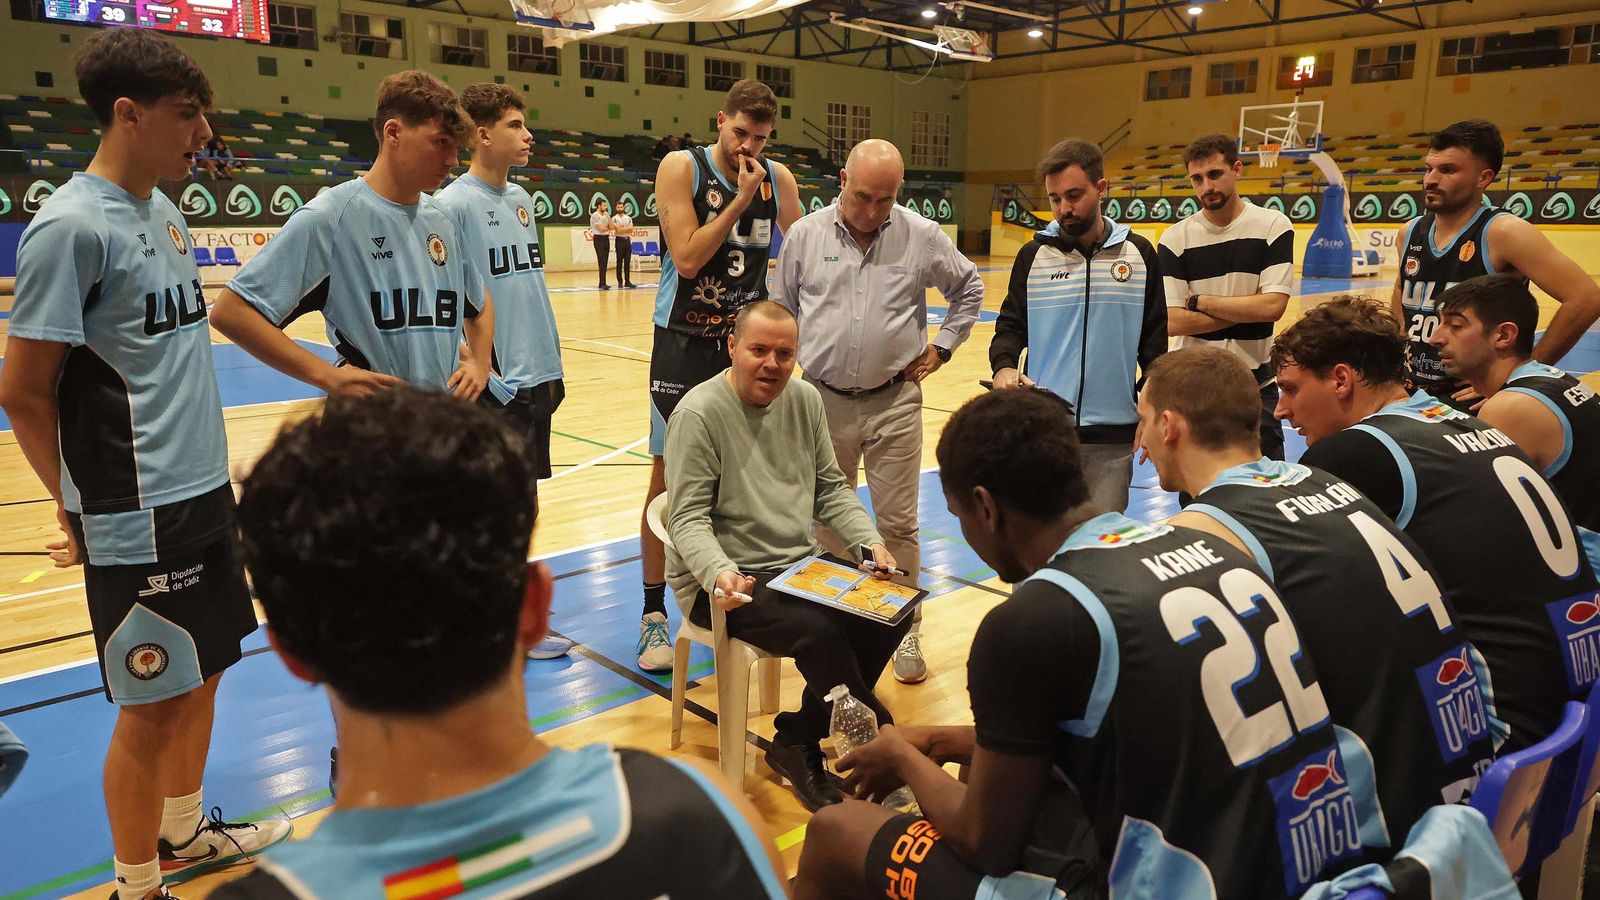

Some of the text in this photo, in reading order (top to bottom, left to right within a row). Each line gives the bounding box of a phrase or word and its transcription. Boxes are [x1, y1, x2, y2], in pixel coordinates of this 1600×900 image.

[101, 6, 125, 22] 39
[201, 18, 224, 33] 32
[1293, 64, 1315, 81] 24
[1369, 230, 1398, 248] Su
[371, 250, 393, 260] vive
[488, 243, 544, 277] ULB
[728, 250, 745, 277] 3
[1050, 270, 1070, 280] vive
[370, 288, 458, 331] ULB
[1402, 279, 1461, 313] UL
[1408, 314, 1441, 343] 20
[1493, 456, 1581, 580] 0
[171, 563, 204, 580] Diputación
[1141, 540, 1225, 582] KANE
[1347, 510, 1454, 634] 4
[172, 575, 200, 591] de Cádiz
[1159, 567, 1332, 769] 22
[1569, 634, 1600, 686] UBA
